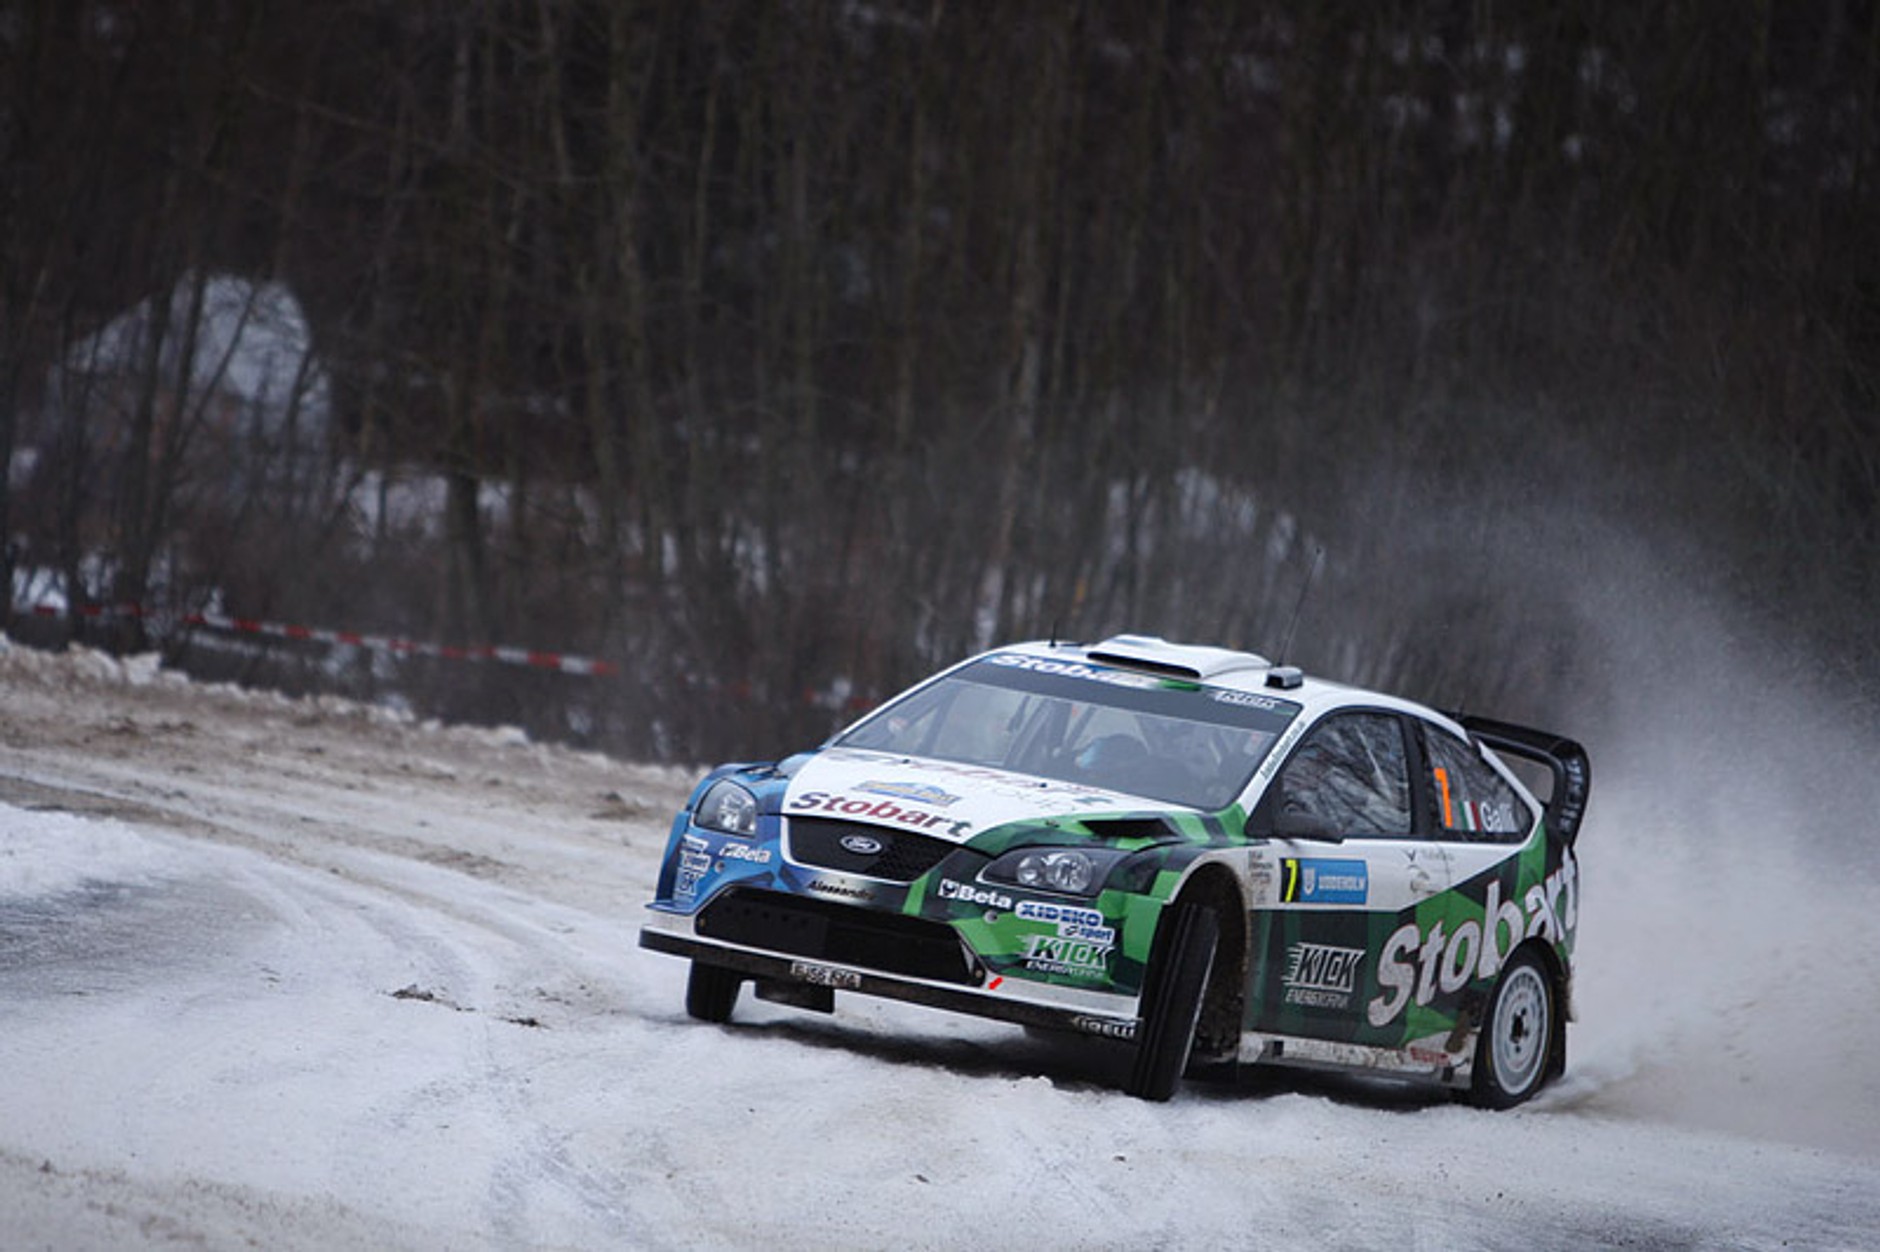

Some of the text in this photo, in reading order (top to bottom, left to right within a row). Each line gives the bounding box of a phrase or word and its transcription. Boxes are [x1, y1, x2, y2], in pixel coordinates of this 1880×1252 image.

[790, 791, 971, 838] Stobart
[959, 885, 1012, 909] Beta
[1285, 859, 1298, 902] 7
[1294, 944, 1365, 992] KICK
